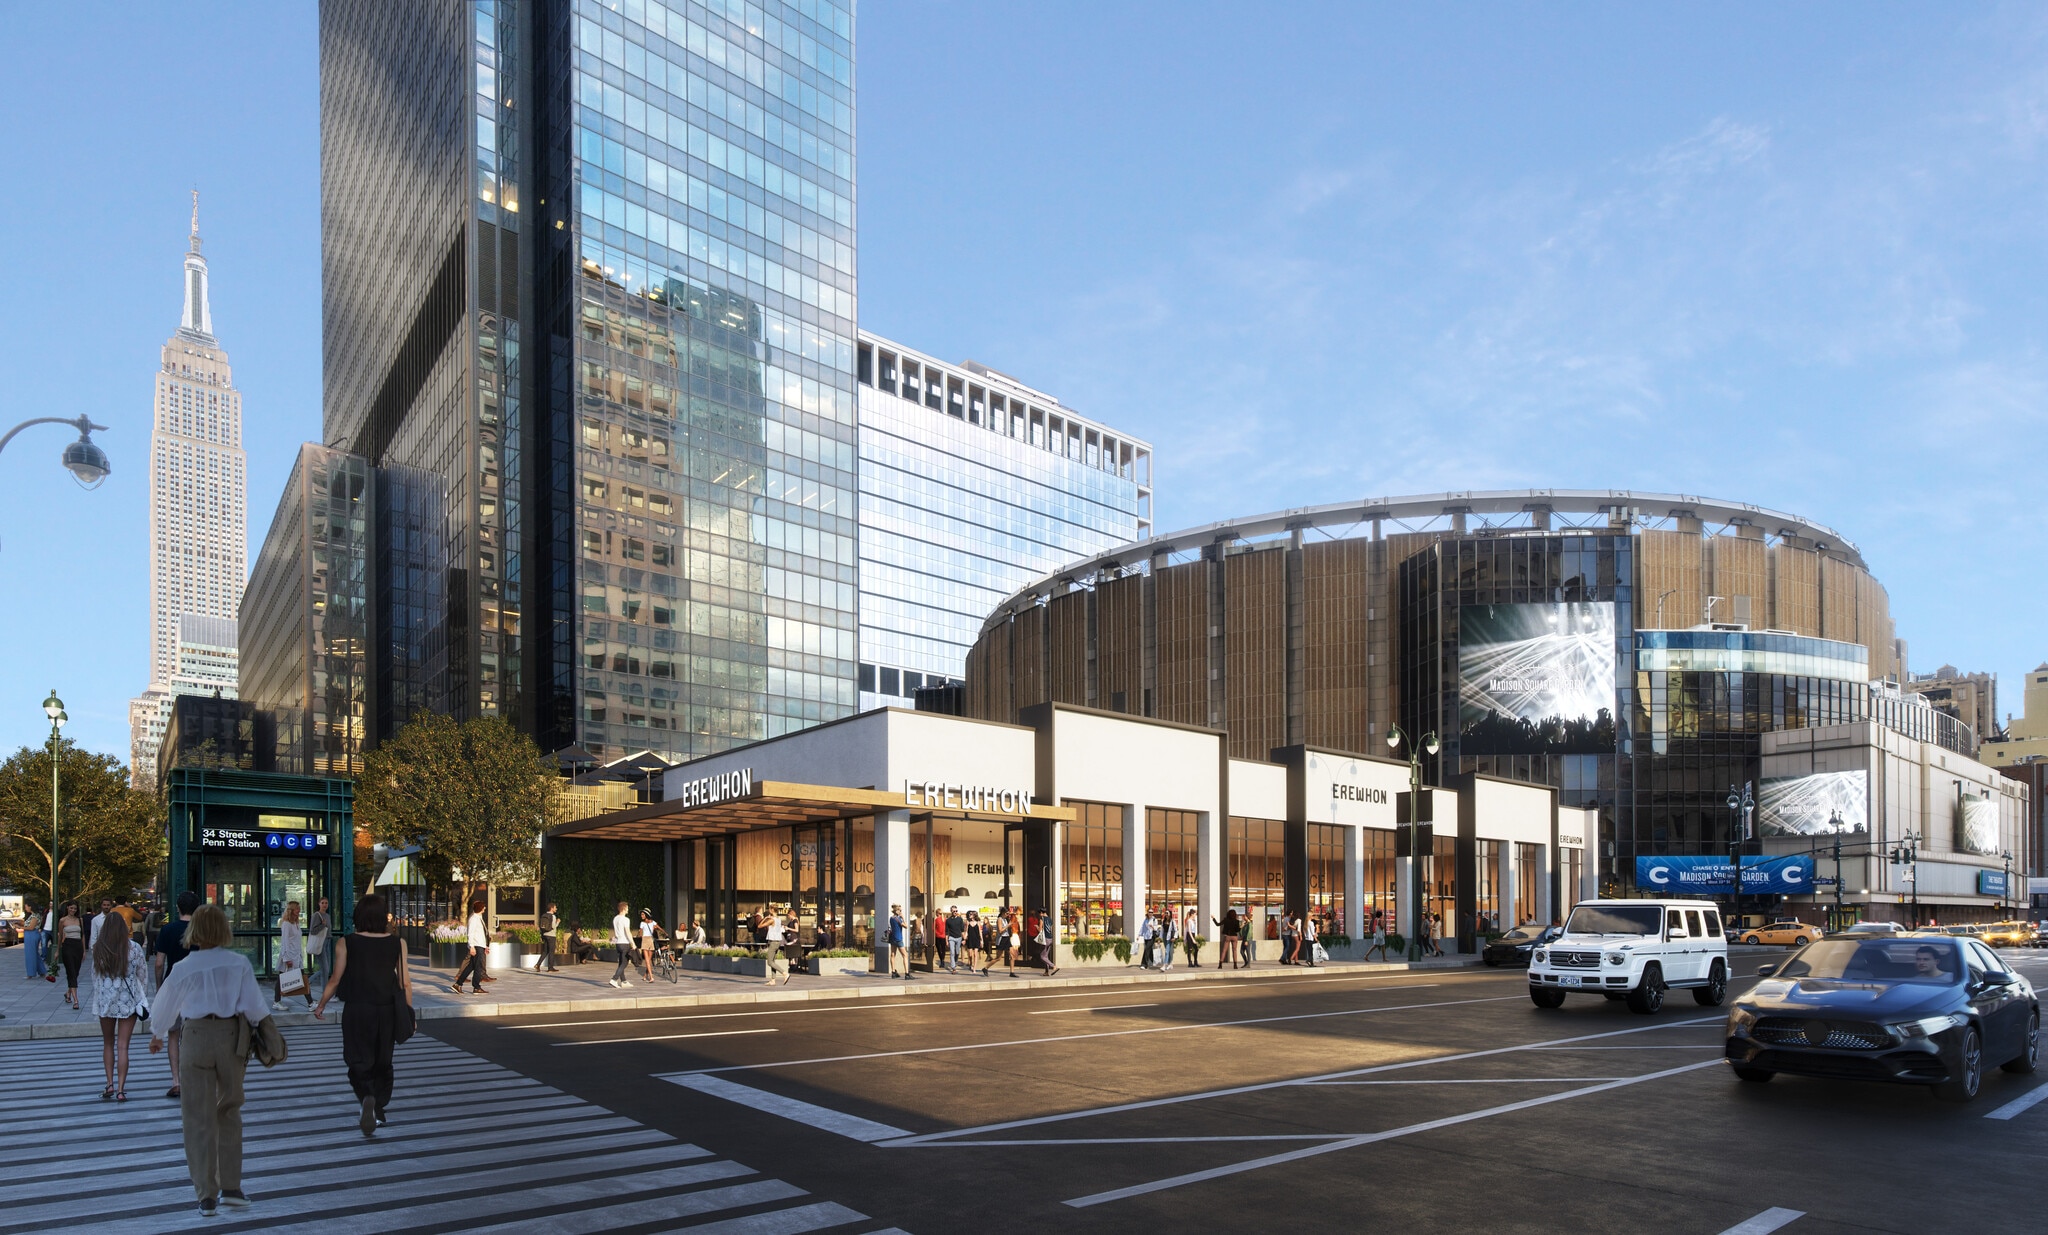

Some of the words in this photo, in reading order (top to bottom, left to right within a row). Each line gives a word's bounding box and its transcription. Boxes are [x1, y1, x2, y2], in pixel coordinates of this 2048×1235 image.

[1489, 679, 1523, 691] MADISON
[683, 767, 751, 808] EREWHON
[904, 779, 1032, 815] EREWHON
[1332, 783, 1387, 805] EREWHON
[202, 829, 215, 838] 34
[202, 838, 225, 847] Penn
[228, 838, 260, 848] Station
[270, 836, 278, 846] A
[287, 837, 295, 846] C
[304, 838, 312, 847] E
[1560, 834, 1583, 845] EREWHON
[836, 861, 844, 872] &
[1648, 866, 1670, 884] C
[1679, 871, 1711, 882] MADISON
[1741, 871, 1769, 882] GARDEN
[1781, 865, 1802, 884] C
